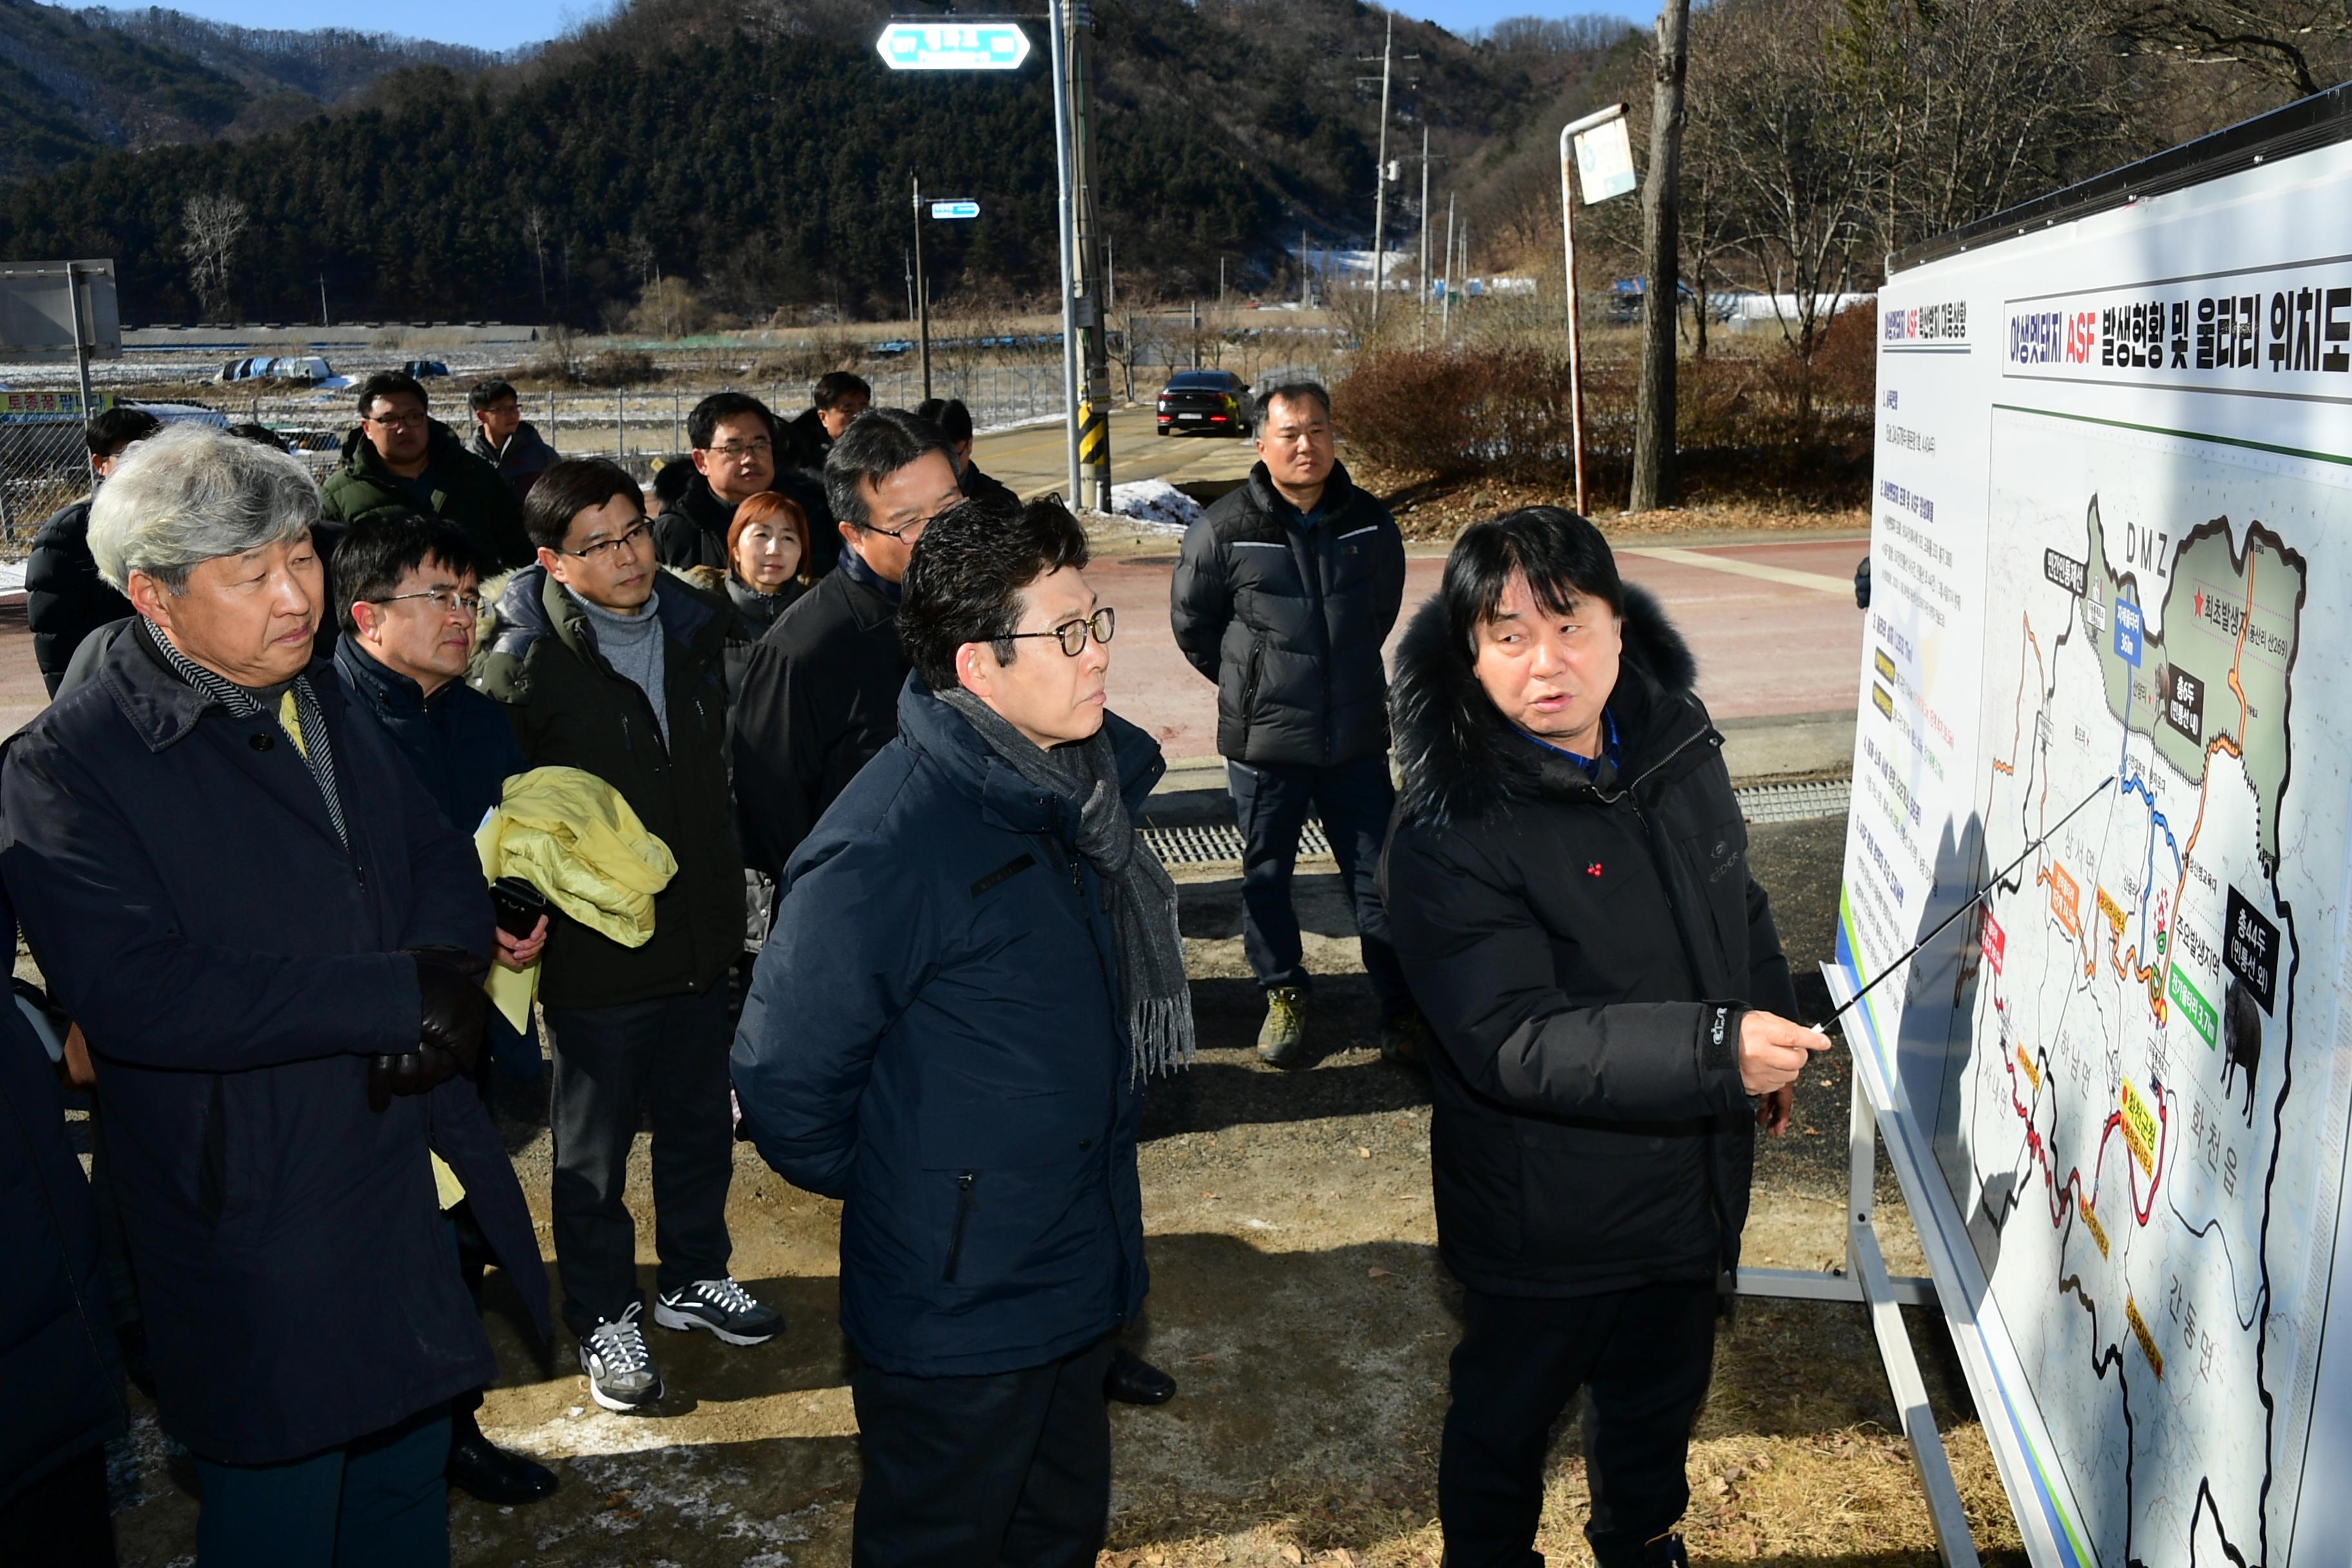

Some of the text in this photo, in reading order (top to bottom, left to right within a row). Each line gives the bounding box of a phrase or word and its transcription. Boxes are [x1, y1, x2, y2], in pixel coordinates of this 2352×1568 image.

[1906, 309, 1917, 339] ASF
[1941, 299, 1966, 339] 대응상황
[2010, 286, 2351, 373] 야생멧돼지 ASF 발생현황 및 울타리 위치도
[8, 394, 56, 411] 토종꿀
[2047, 551, 2084, 593] 민간인통제선
[2176, 675, 2195, 707] 총6두
[2176, 914, 2220, 986] 주요발생지역
[2238, 907, 2267, 958] 총44두
[2230, 936, 2268, 995] (민통선 외)
[2171, 972, 2199, 1021] 전기울타리
[2129, 1091, 2157, 1152] 화천군청
[2191, 1099, 2238, 1199] 화천읍
[2169, 1273, 2214, 1385] 간동면
